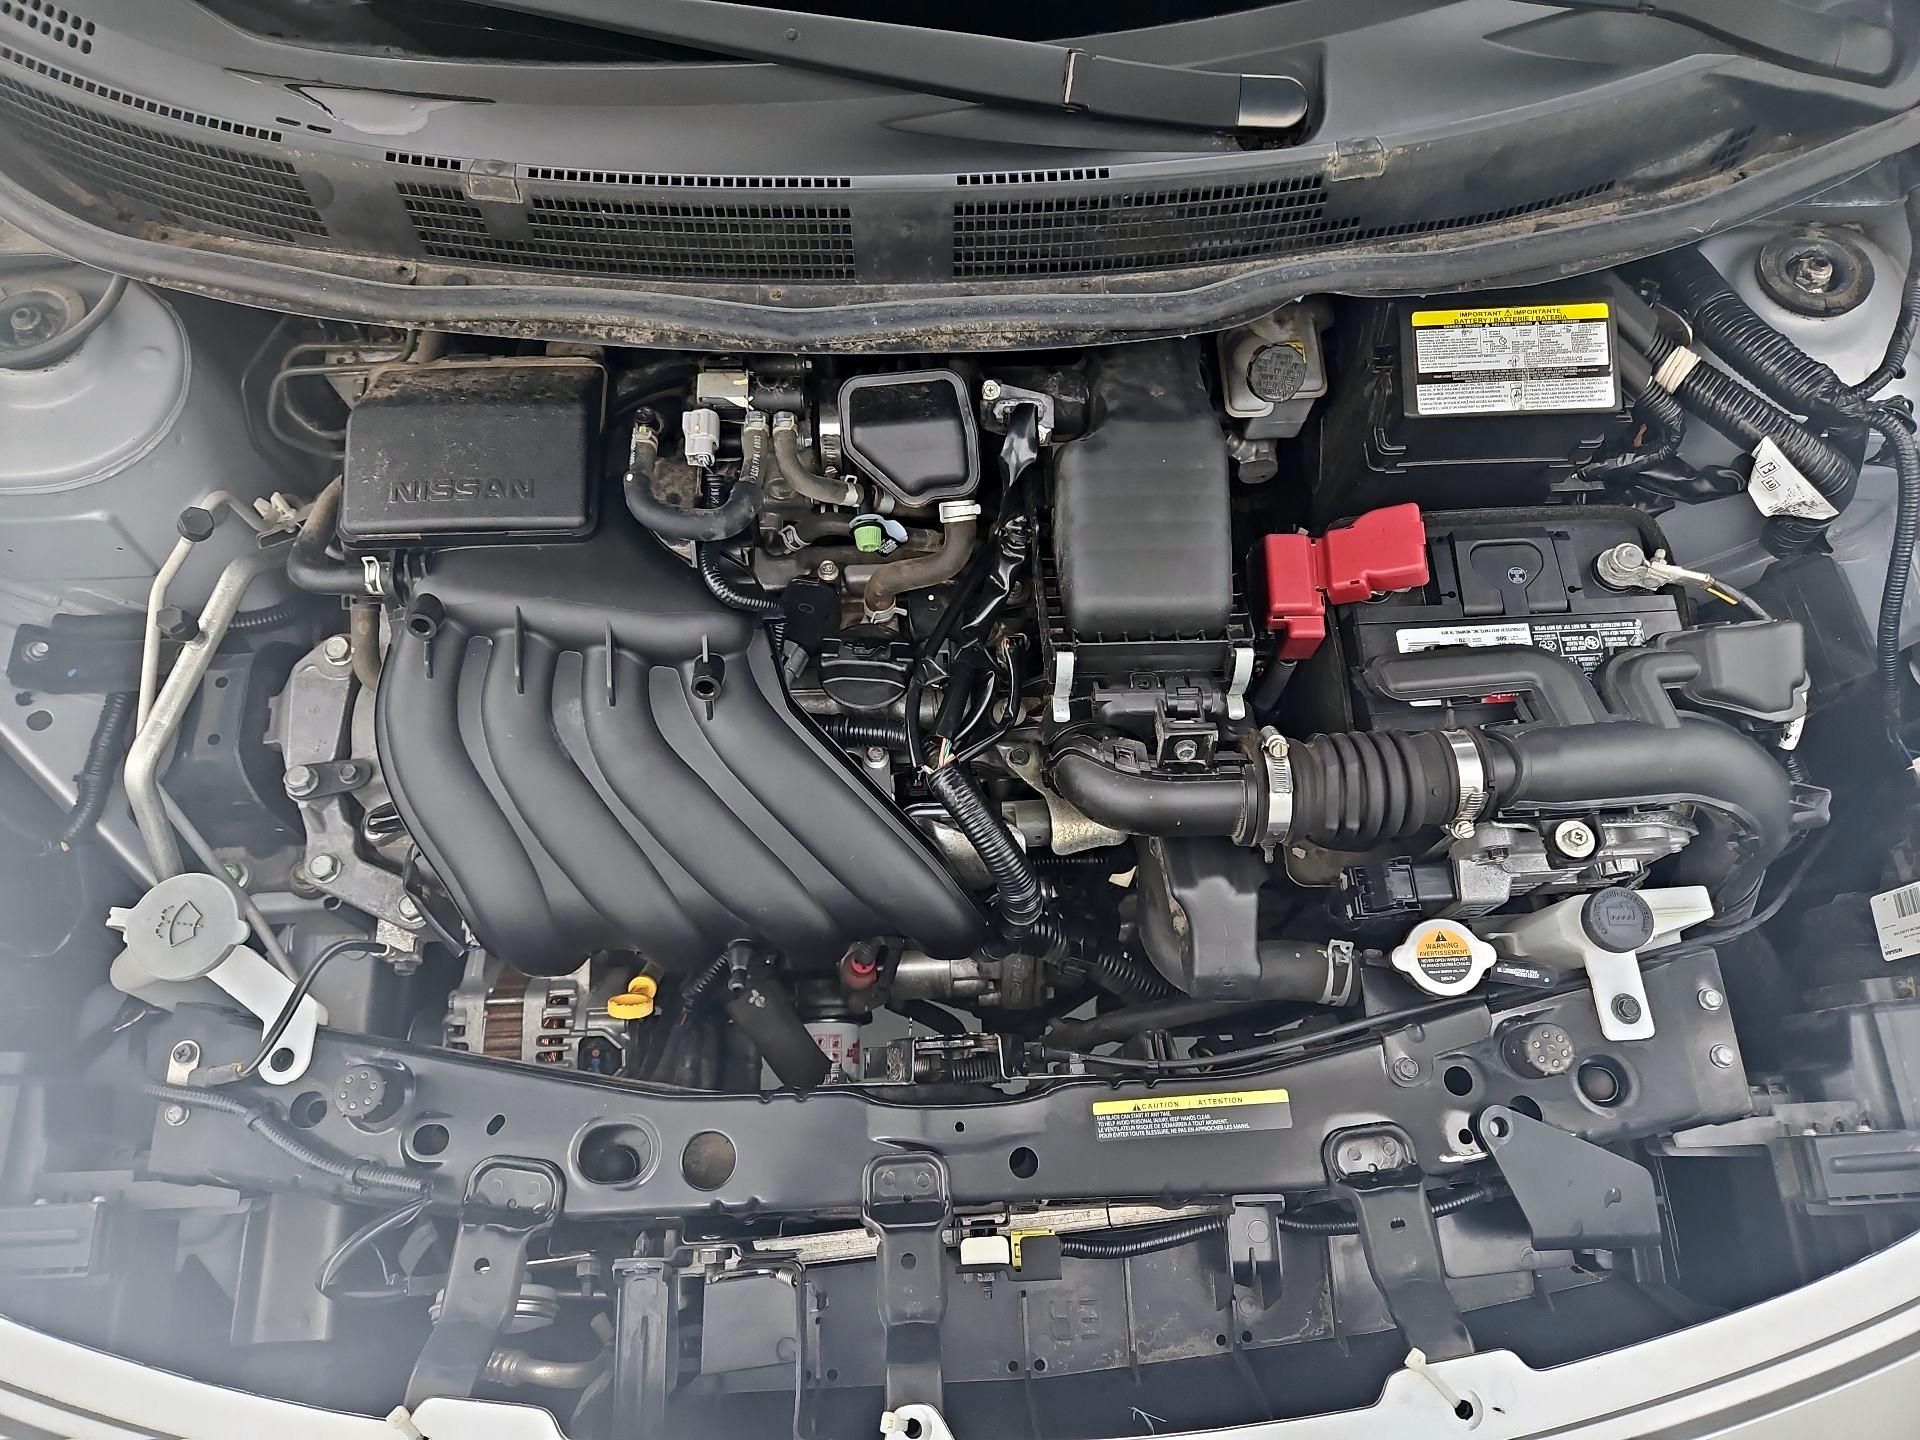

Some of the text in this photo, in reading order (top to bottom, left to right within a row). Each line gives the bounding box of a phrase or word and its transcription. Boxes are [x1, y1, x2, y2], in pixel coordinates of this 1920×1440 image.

[387, 477, 534, 503] NISSAN
[1141, 1101, 1178, 1109] CAUTION
[1197, 1096, 1242, 1105] ATTENTION
